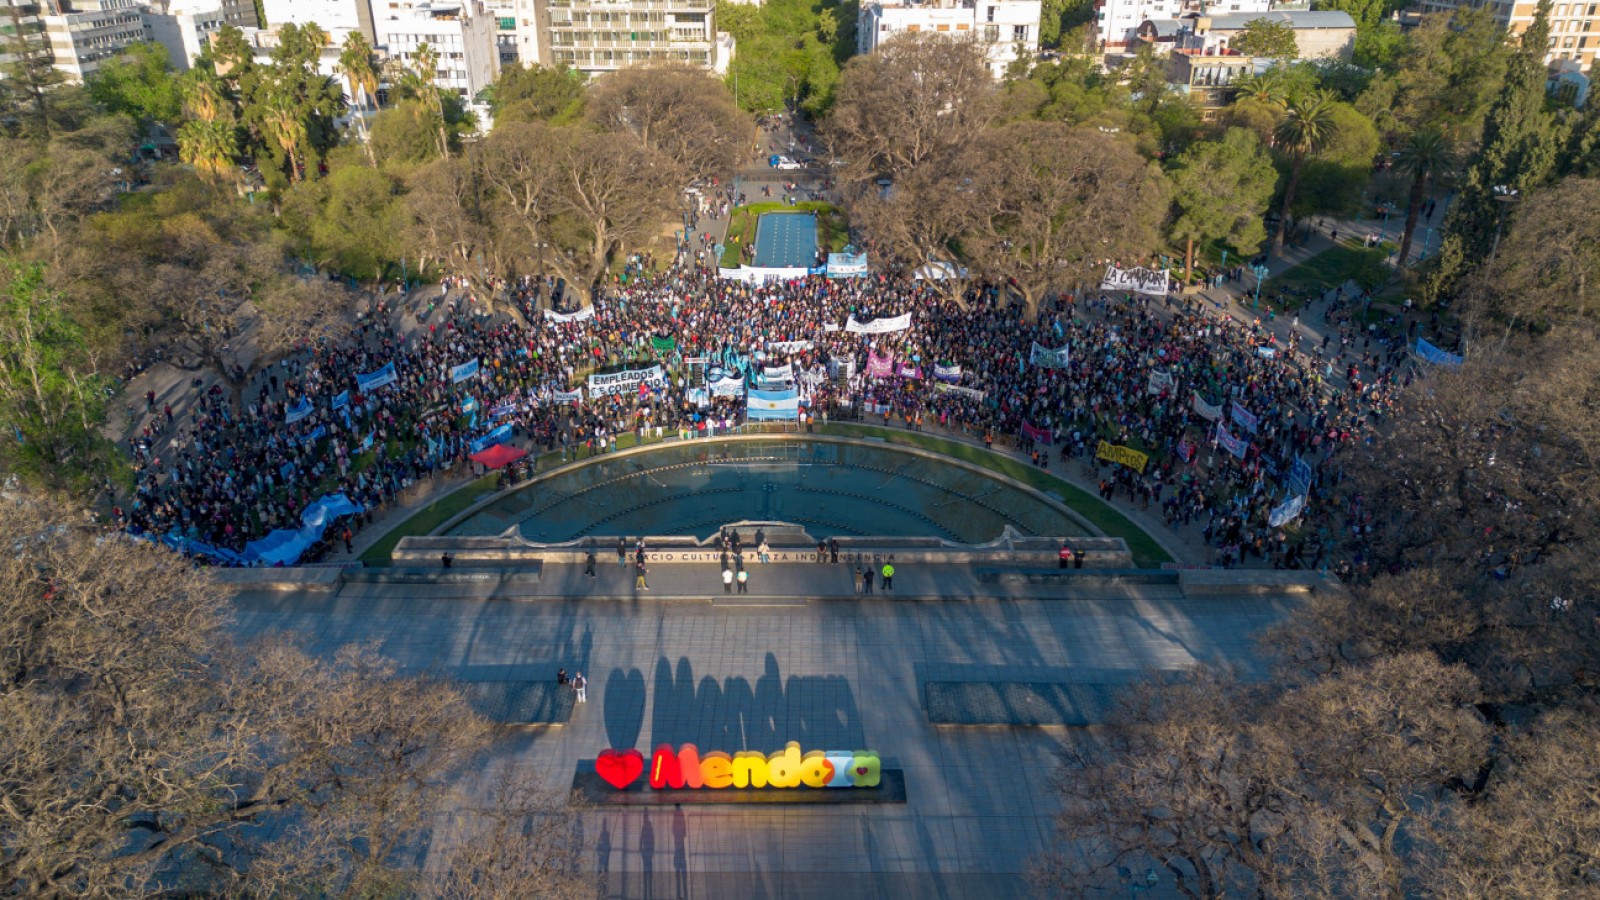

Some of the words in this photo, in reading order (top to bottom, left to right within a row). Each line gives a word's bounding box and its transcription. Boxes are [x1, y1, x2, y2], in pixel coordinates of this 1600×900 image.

[1104, 267, 1117, 283] LA
[594, 370, 654, 384] EMPLEADOS
[608, 378, 661, 394] COMEIO
